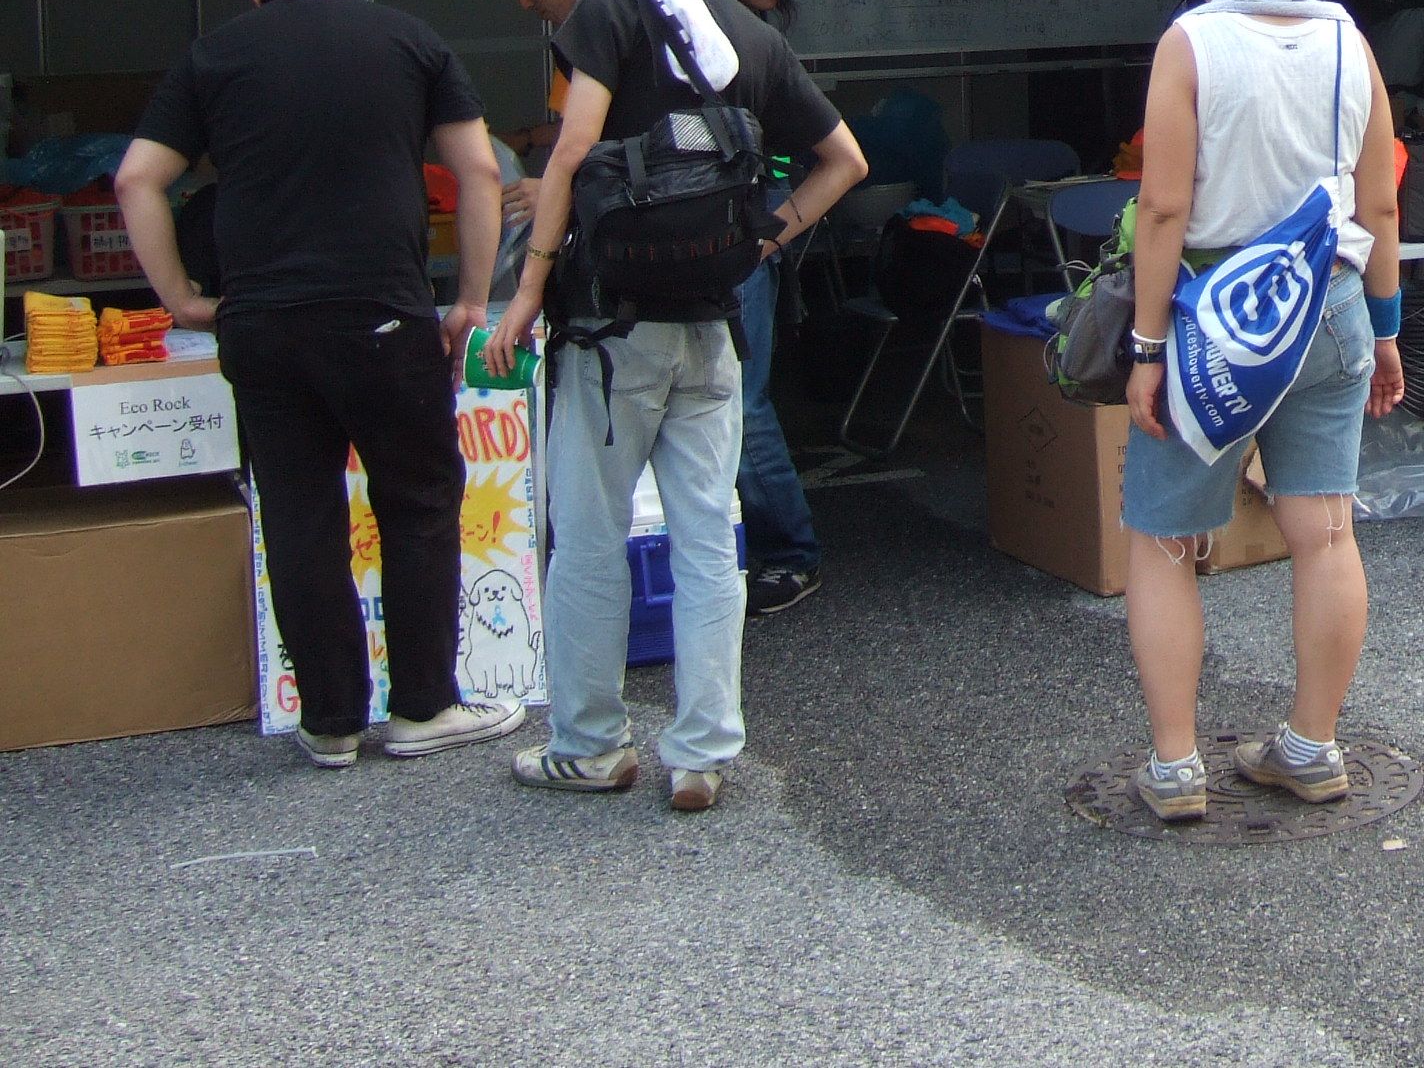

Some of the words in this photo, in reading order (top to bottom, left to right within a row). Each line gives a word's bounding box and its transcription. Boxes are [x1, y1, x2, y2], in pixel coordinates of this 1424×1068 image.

[120, 401, 149, 415] Eco
[153, 396, 192, 412] Rock
[89, 412, 224, 440] キャンペーン受付
